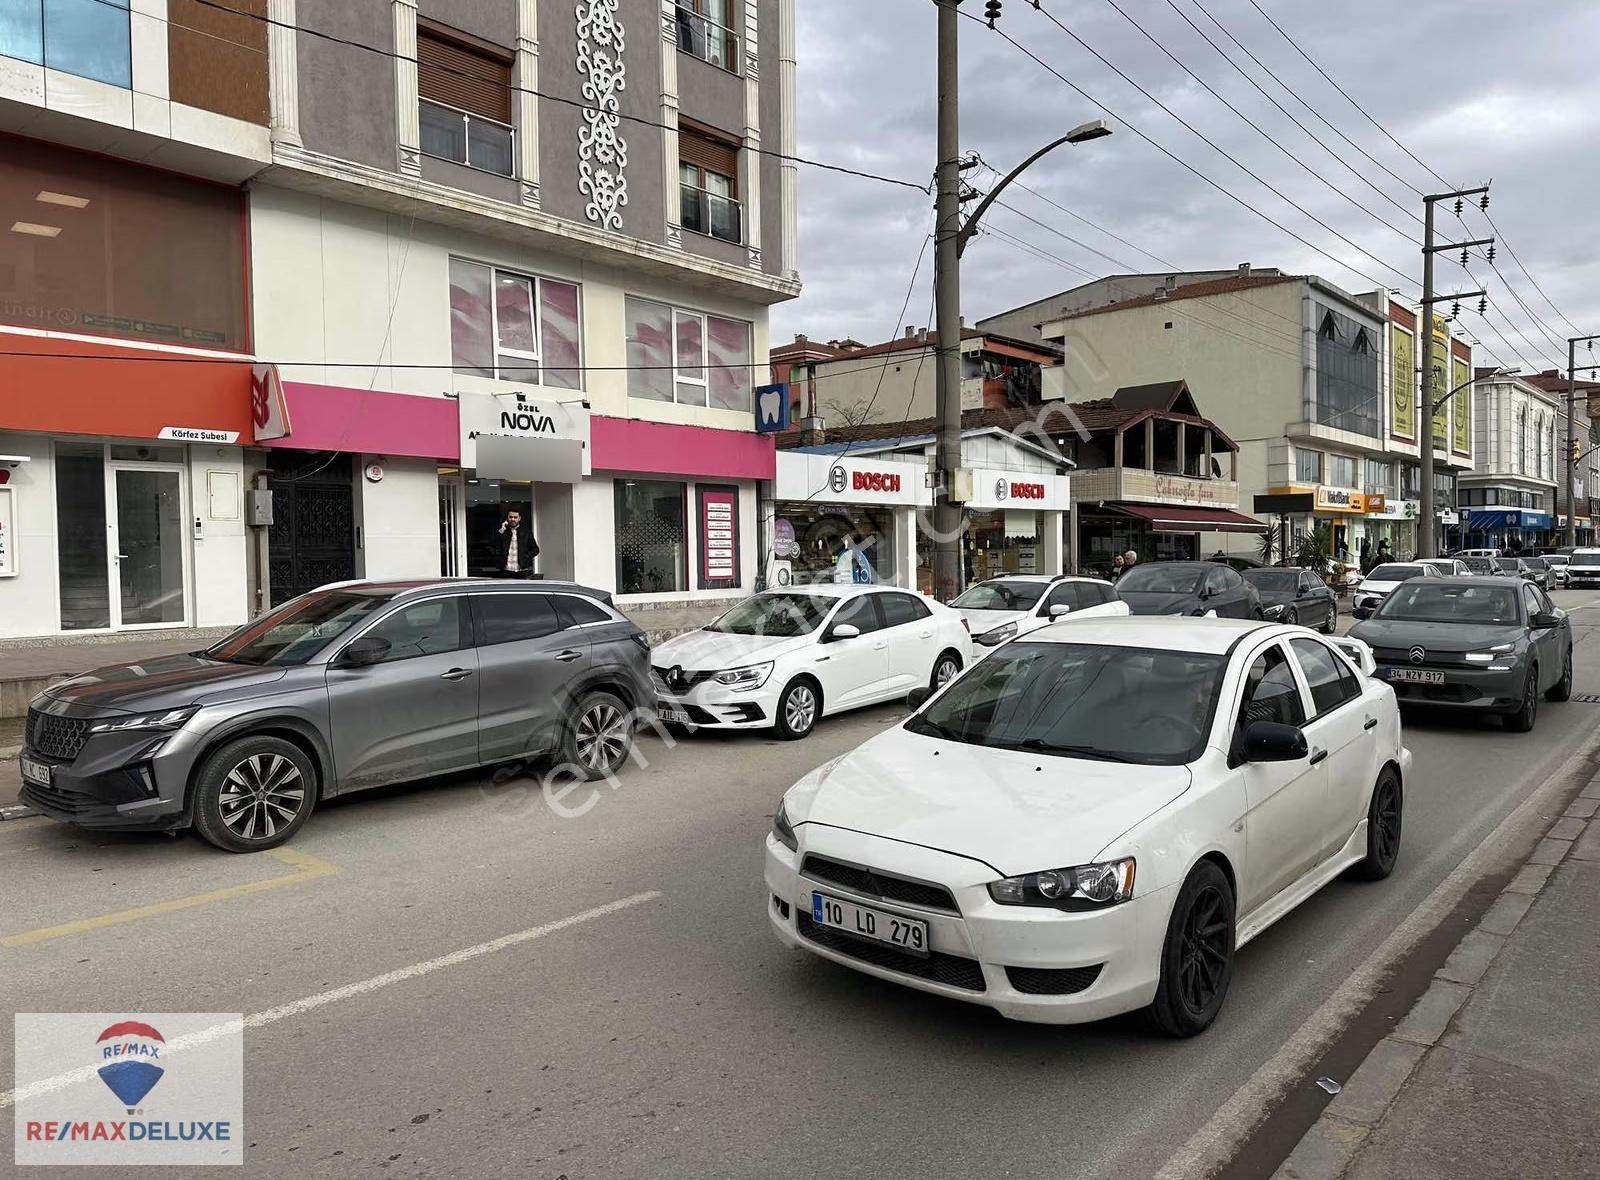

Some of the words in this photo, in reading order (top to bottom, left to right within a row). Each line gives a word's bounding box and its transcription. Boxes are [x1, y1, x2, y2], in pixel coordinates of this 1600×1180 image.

[517, 403, 540, 412] ÖZEL
[501, 412, 556, 433] NOVA
[172, 429, 199, 439] Körfez
[200, 432, 228, 441] Şubesi
[852, 471, 901, 492] BOSCH
[1011, 482, 1045, 499] BOSCH
[1391, 670, 1401, 678] 34
[1426, 672, 1442, 681] 917
[825, 901, 842, 924] 10
[856, 909, 876, 934] LD
[890, 919, 922, 948] 279
